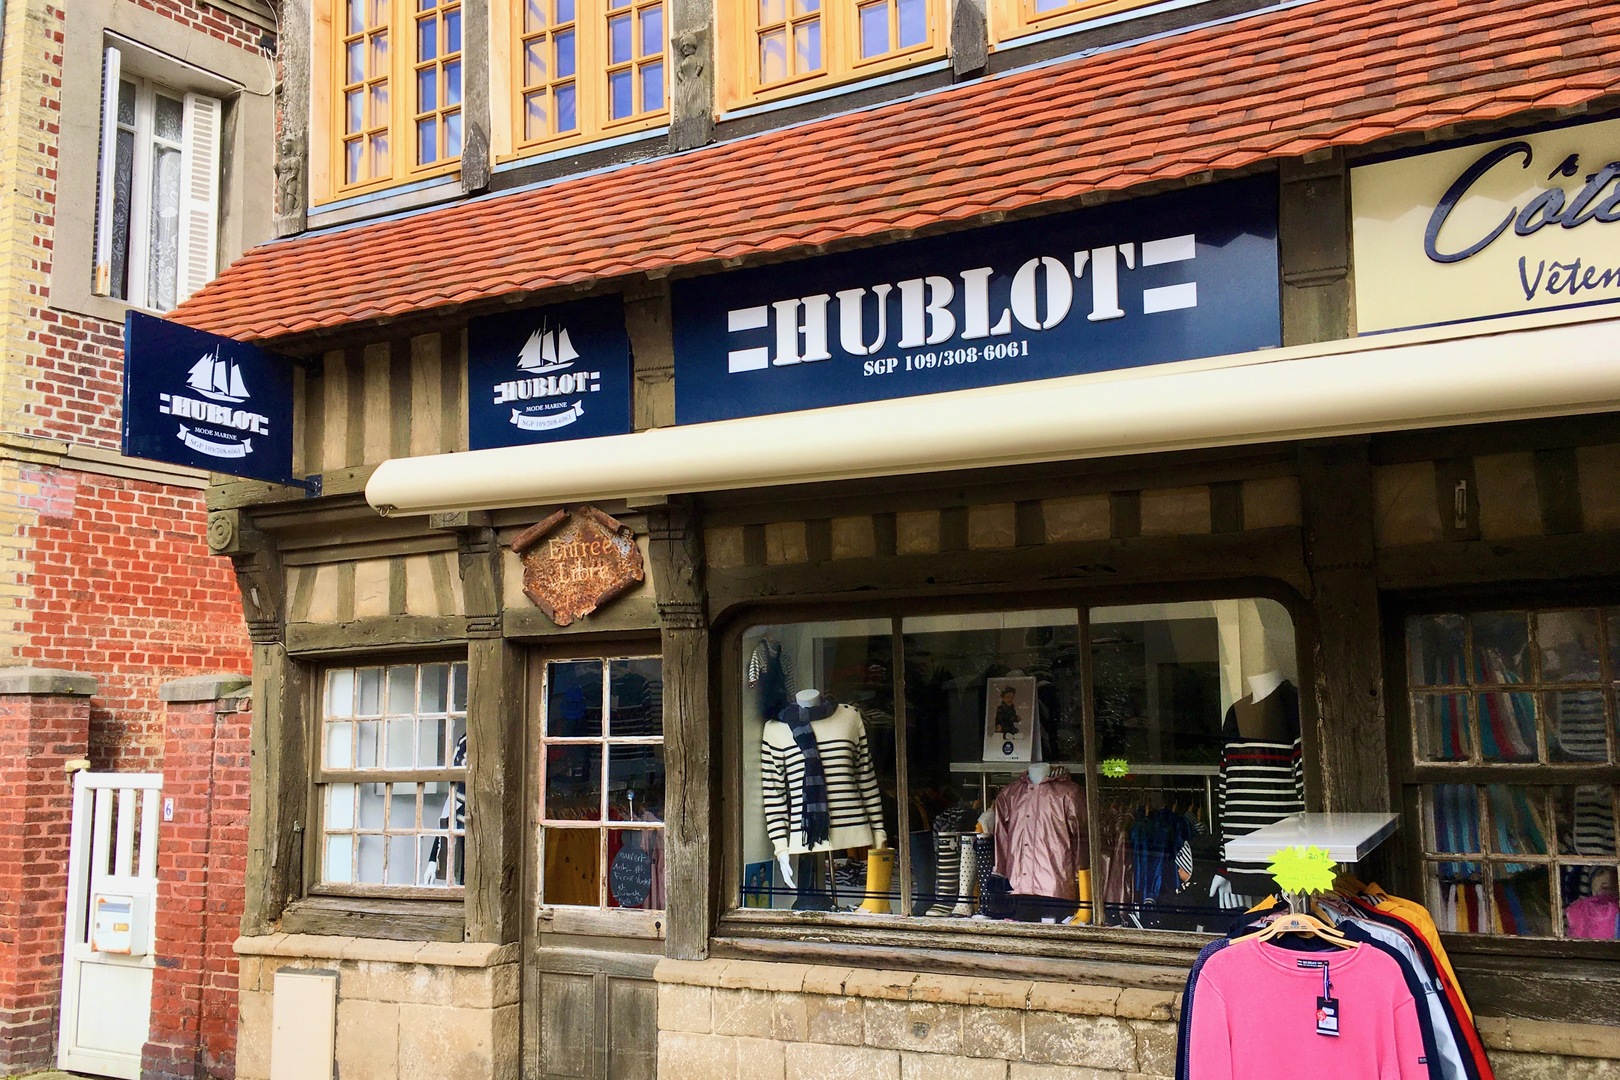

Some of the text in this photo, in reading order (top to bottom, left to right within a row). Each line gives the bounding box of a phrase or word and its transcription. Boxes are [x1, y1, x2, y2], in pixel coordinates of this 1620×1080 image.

[772, 242, 1136, 367] HUBLOT
[863, 340, 1029, 376] SGP 109/308-6061
[500, 371, 590, 402] HUBLOT
[171, 395, 263, 433] HUBLOT
[526, 402, 568, 412] MODE MARINE
[194, 427, 238, 440] MODE MARINE
[165, 803, 171, 815] 6
